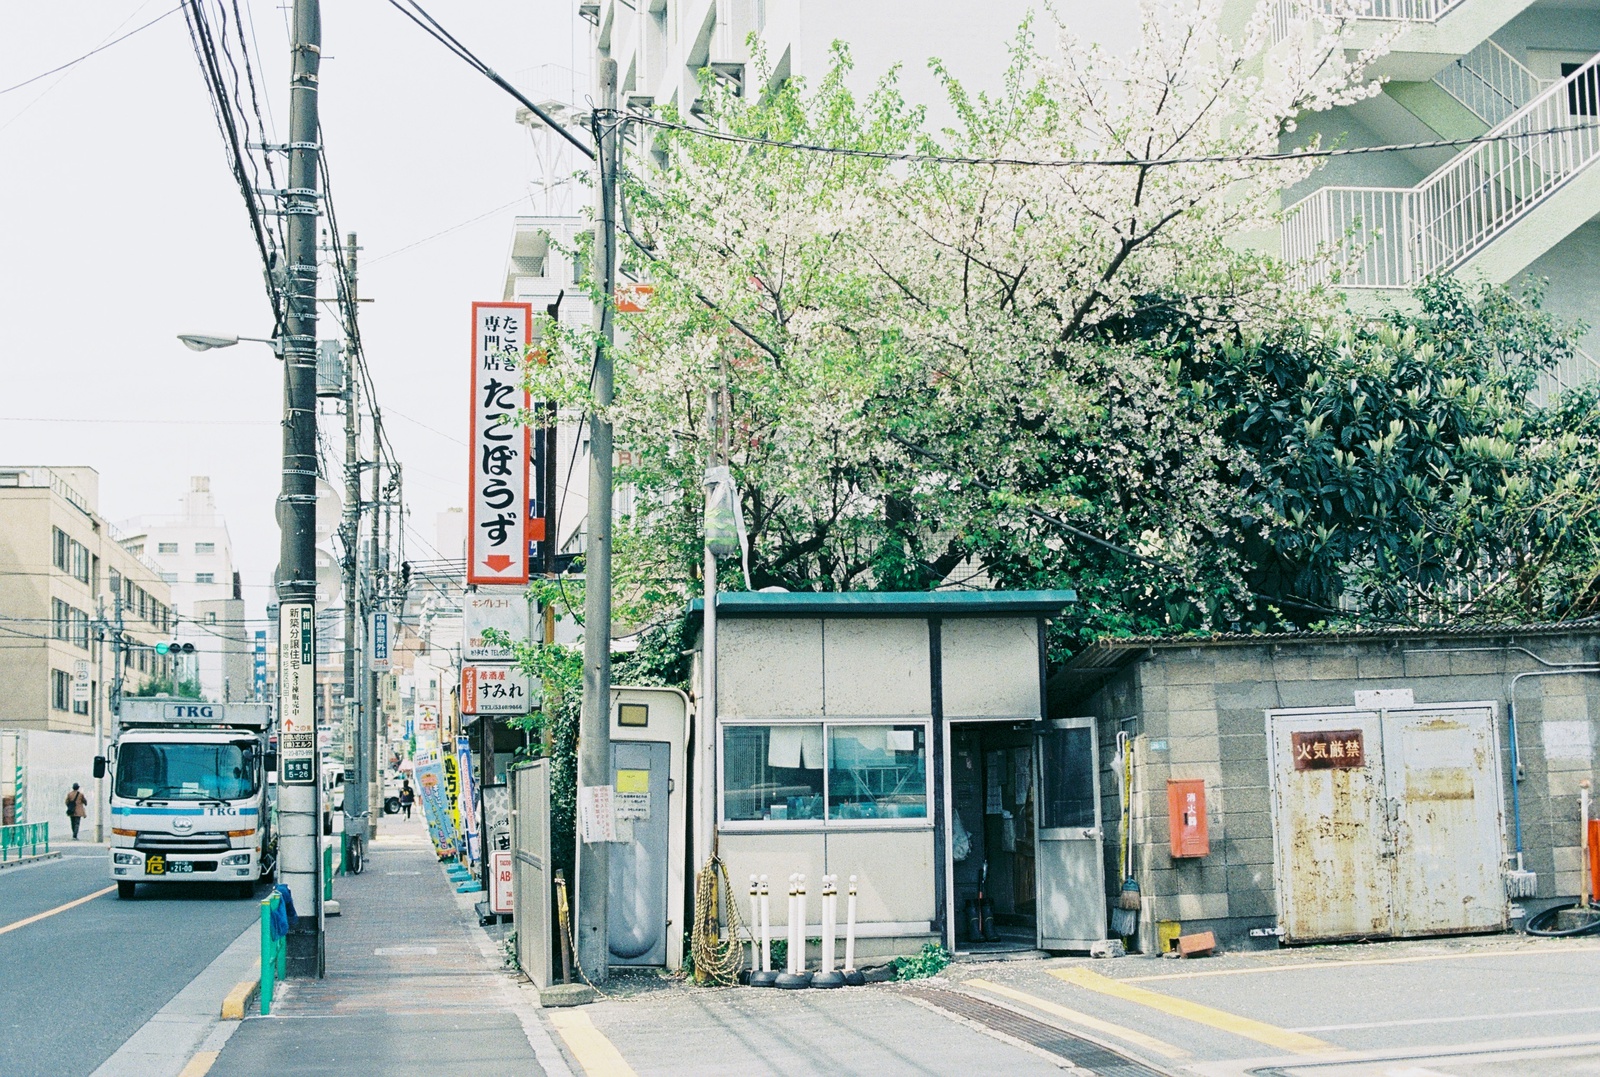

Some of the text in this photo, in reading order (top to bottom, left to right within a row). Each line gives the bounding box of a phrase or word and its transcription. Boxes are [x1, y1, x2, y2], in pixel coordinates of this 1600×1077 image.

[484, 315, 500, 371] 専門店
[502, 315, 518, 372] たこやき
[481, 377, 518, 547] たこぼうず
[480, 671, 505, 680] 居酒屋
[478, 682, 524, 699] すみれ
[174, 705, 214, 718] TRG
[1297, 740, 1361, 761] 火気厳禁
[207, 807, 237, 816] TRG
[1187, 793, 1198, 826] 消火器
[147, 855, 165, 874] 危
